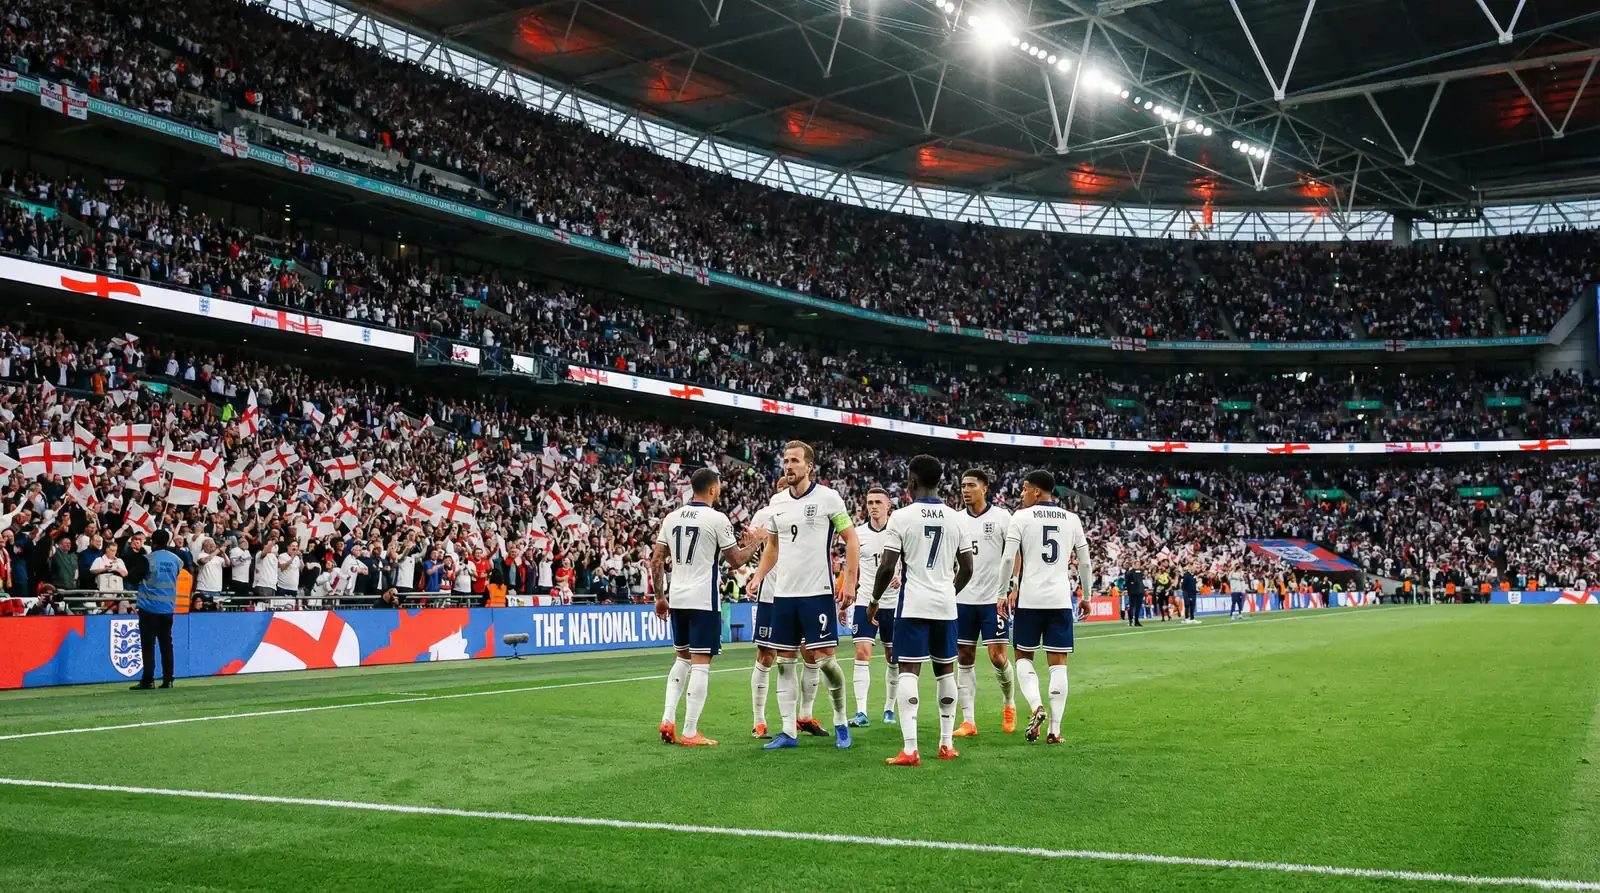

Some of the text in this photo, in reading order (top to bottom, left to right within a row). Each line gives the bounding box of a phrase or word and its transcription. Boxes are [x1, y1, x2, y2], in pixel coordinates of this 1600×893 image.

[681, 511, 698, 519] KANE
[921, 509, 944, 518] SAKA
[791, 524, 798, 542] 9
[672, 525, 700, 565] 17
[924, 525, 944, 570] 7
[972, 540, 978, 555] 5
[1041, 525, 1060, 565] 5
[533, 613, 565, 647] THE
[568, 611, 639, 645] NATIONAL
[819, 613, 827, 631] 9
[997, 614, 1004, 629] 5
